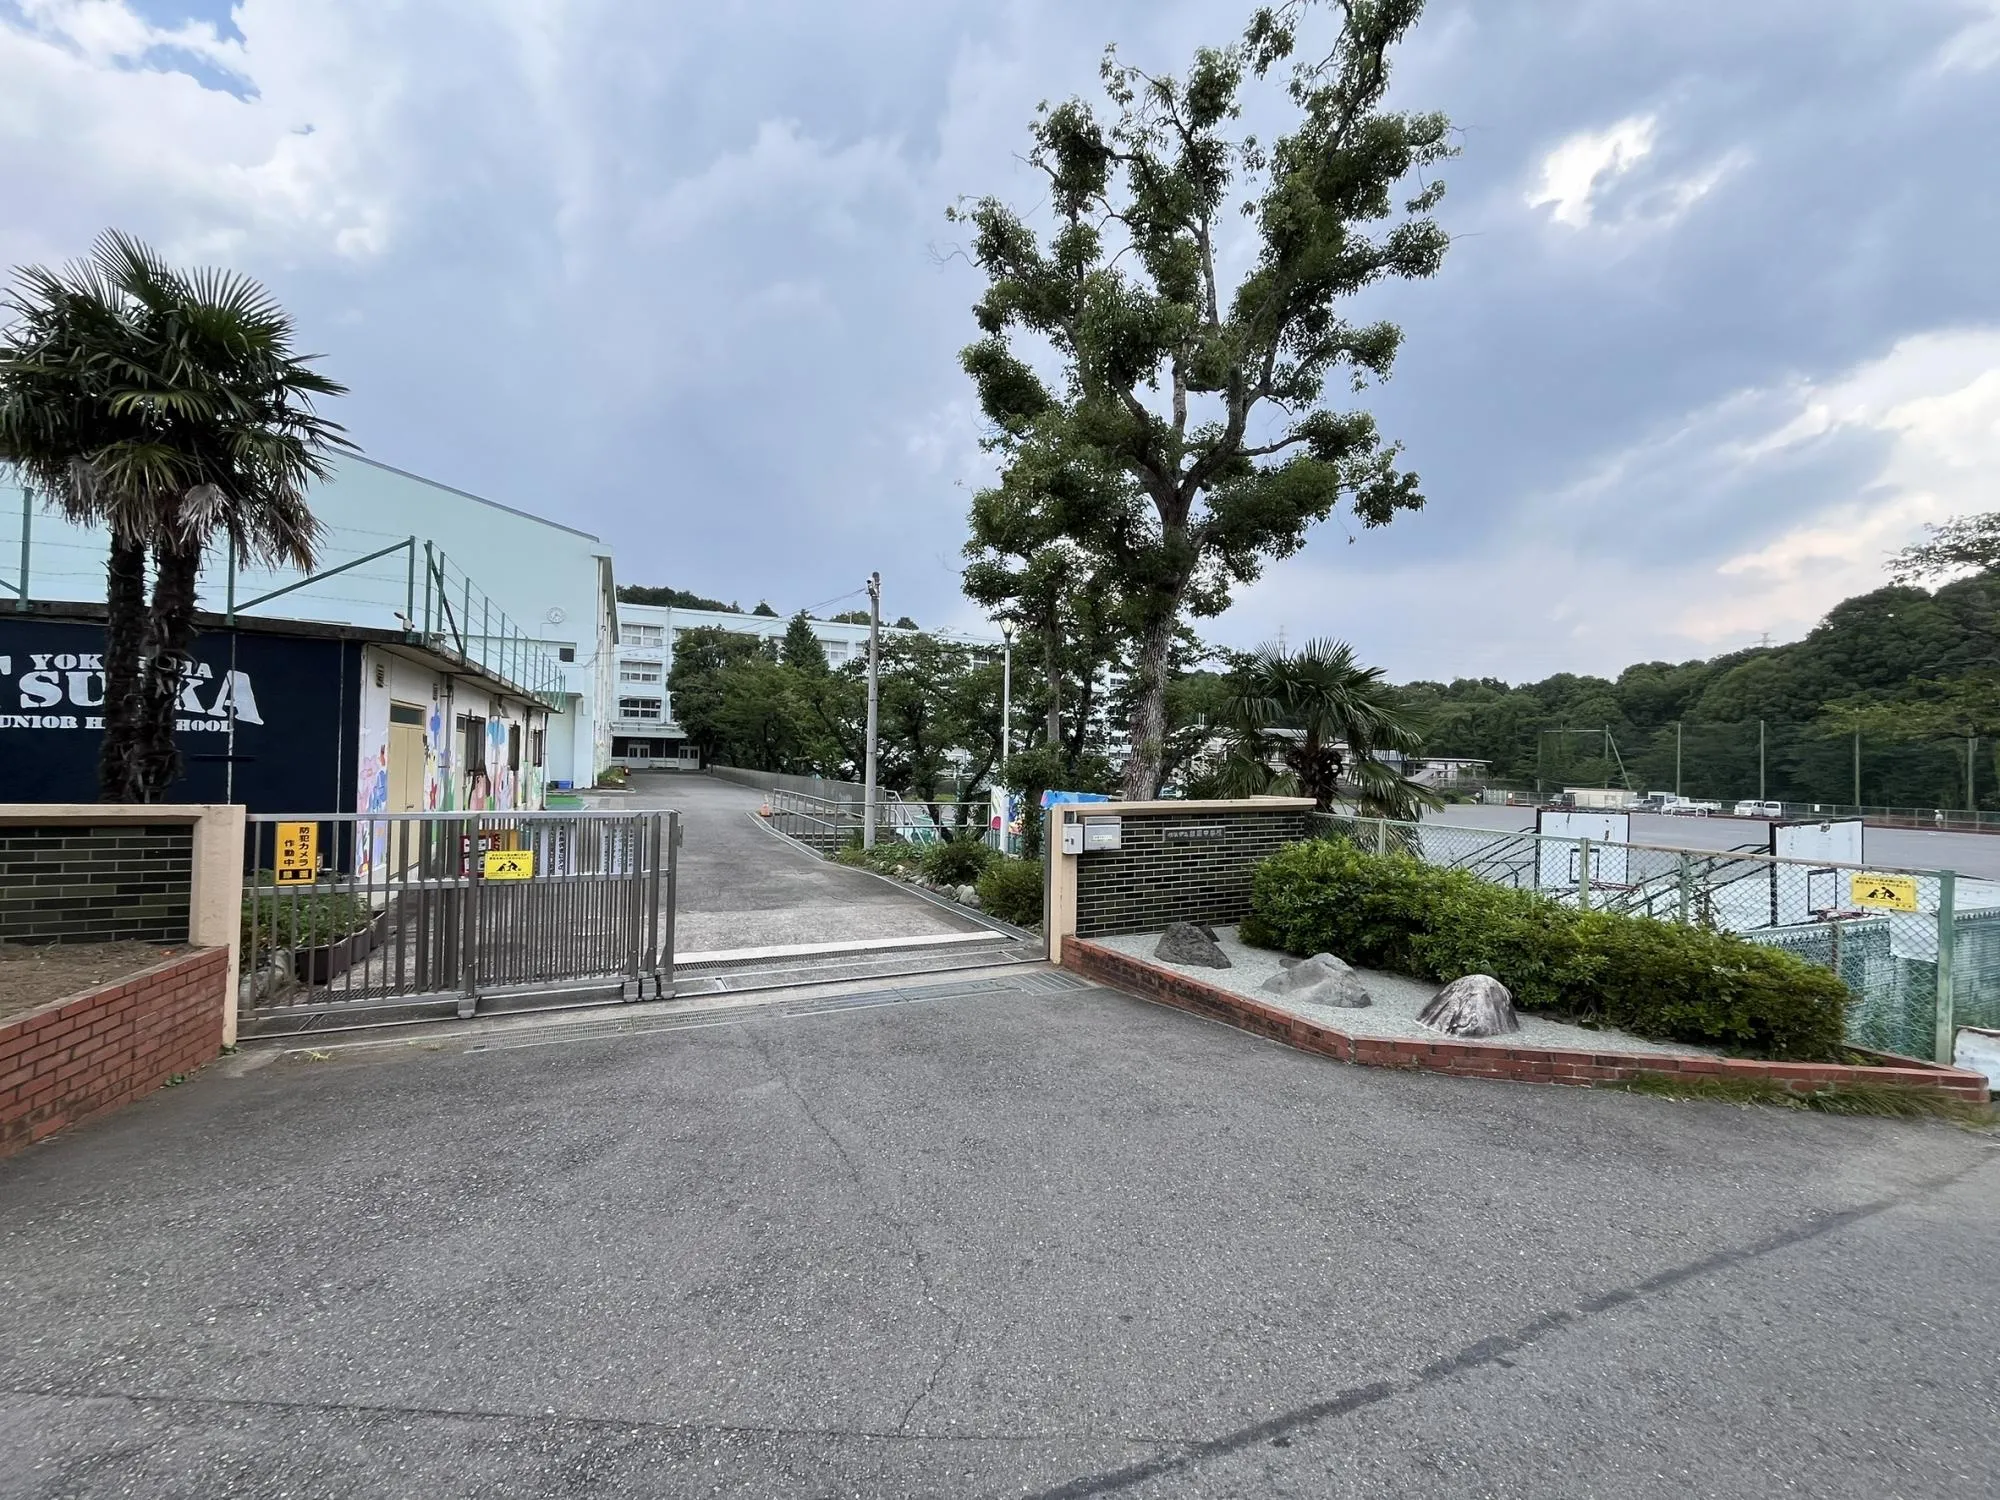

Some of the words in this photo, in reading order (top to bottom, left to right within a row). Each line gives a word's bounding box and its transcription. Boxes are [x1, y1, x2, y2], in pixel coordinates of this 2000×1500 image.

[29, 654, 214, 679] YOKMA
[0, 656, 264, 725] SUKA
[0, 715, 79, 729] UNIOR
[175, 719, 233, 732] HOOL
[284, 839, 295, 866] 作動中
[299, 826, 310, 867] 防犯カメラ
